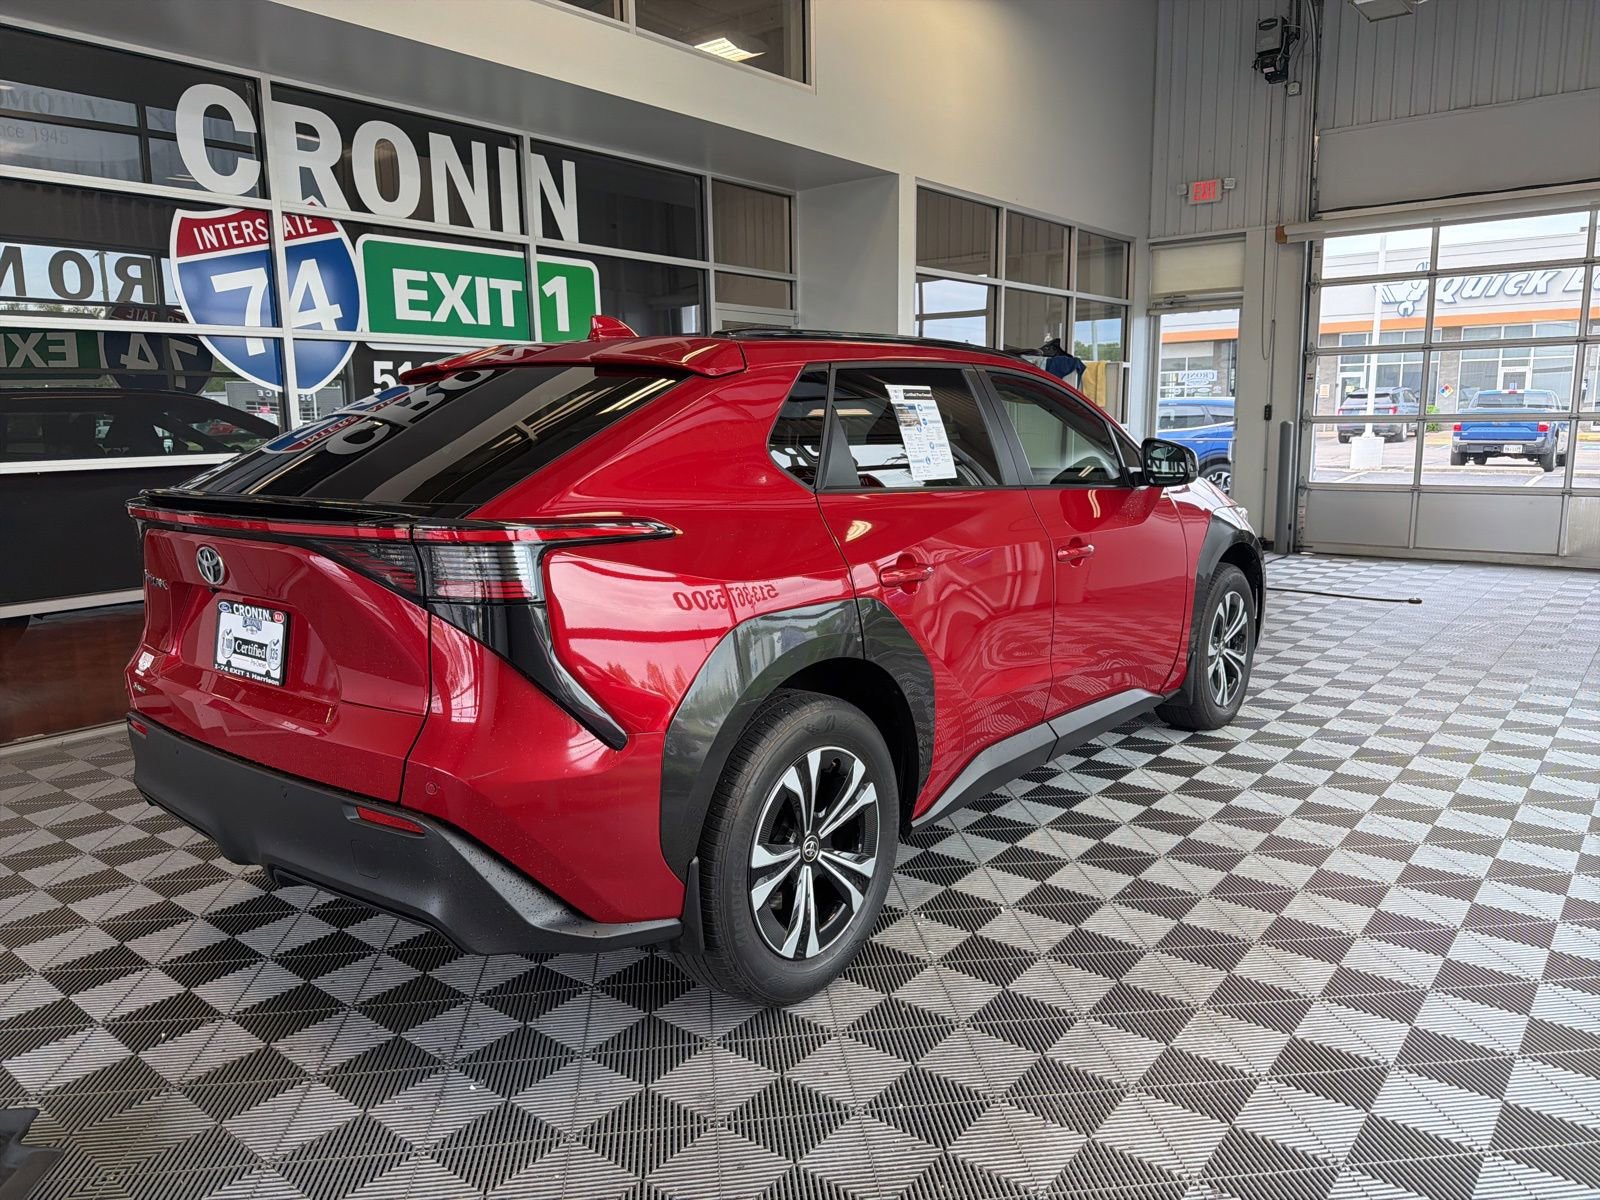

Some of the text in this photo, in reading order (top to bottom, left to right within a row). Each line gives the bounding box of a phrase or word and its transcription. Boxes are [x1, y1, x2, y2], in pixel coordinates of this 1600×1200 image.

[175, 83, 580, 244] CRONIN
[1193, 181, 1217, 201] EXIT
[193, 214, 318, 251] INTERSATE
[392, 268, 570, 332] EXIT 1
[1436, 270, 1561, 304] QUICK
[211, 258, 342, 357] 74
[233, 603, 270, 621] CRONIN
[235, 640, 266, 659] Certified
[229, 667, 245, 675] EXIT
